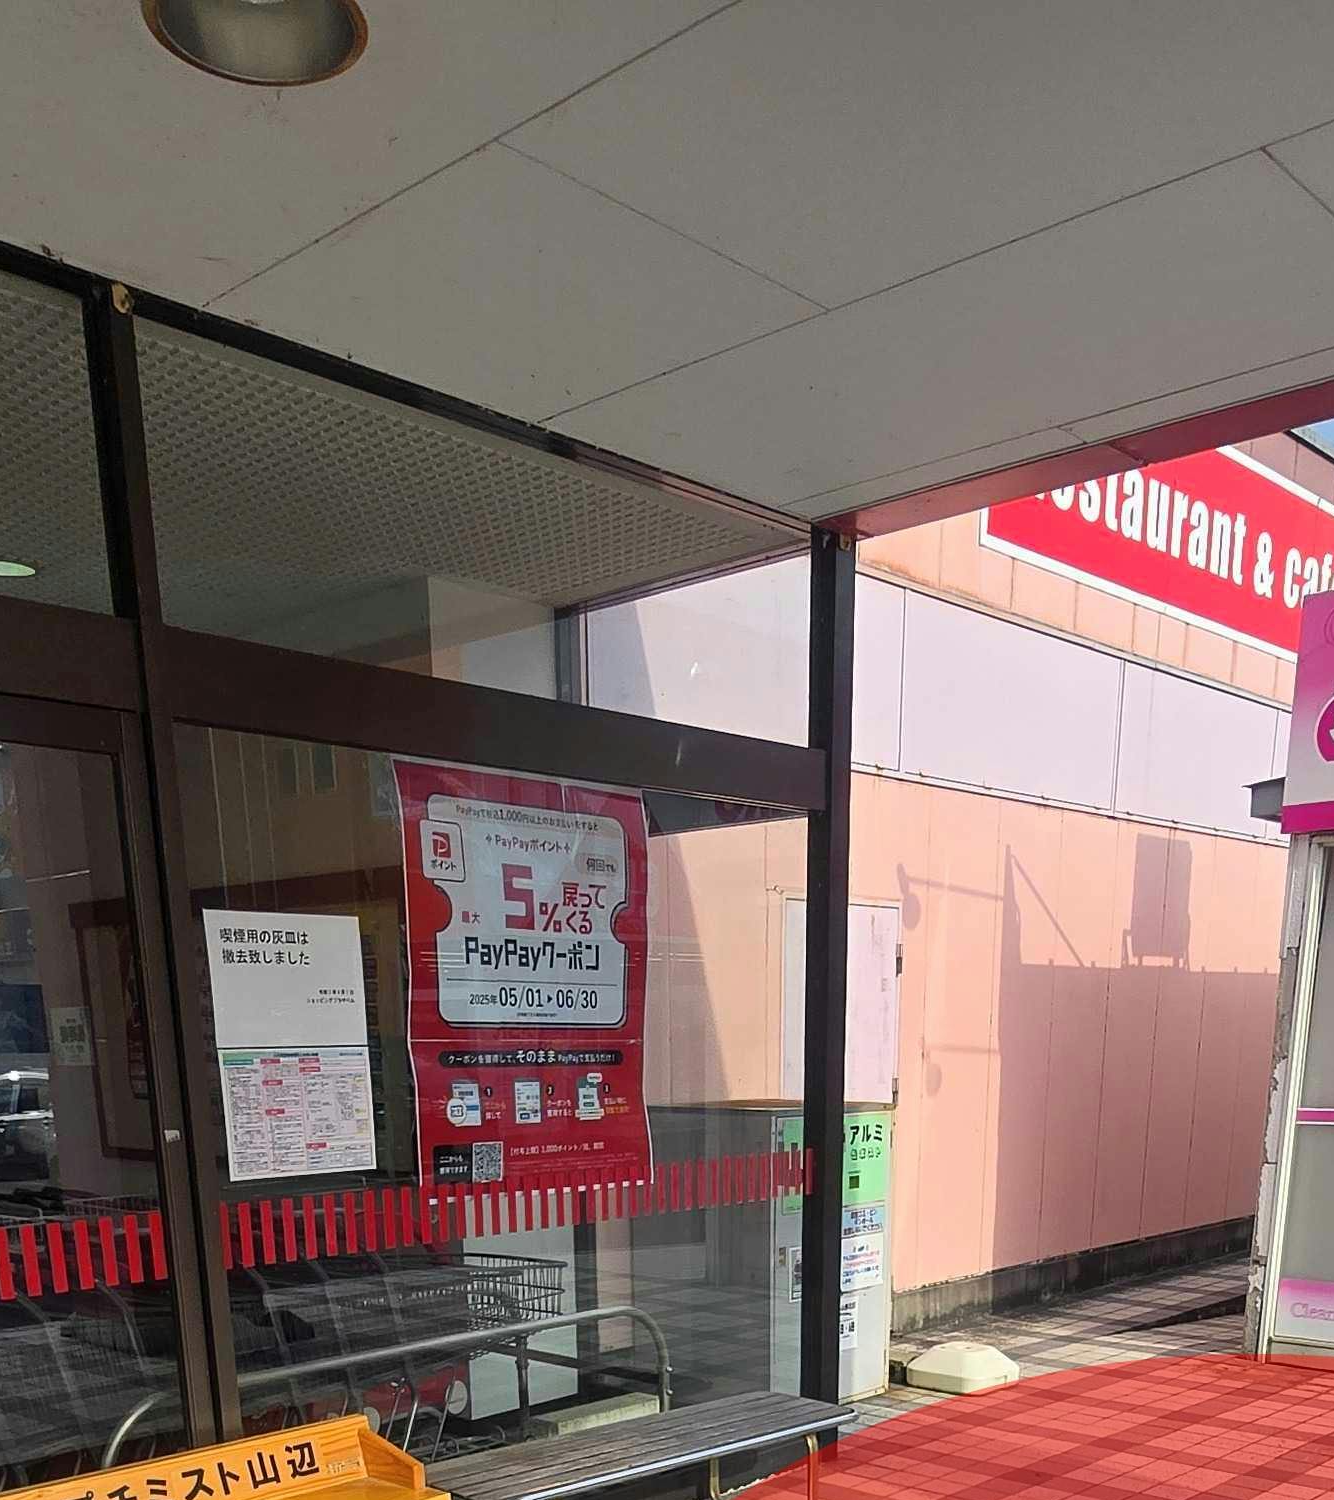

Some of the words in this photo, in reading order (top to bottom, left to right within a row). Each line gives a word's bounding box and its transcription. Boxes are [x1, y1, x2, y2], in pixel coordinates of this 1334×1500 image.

[1034, 469, 1247, 586] staurant
[1254, 532, 1274, 599] &
[494, 835, 565, 854] PayPayポイント
[430, 860, 457, 872] ポイント
[562, 881, 607, 910] 戻って
[565, 911, 594, 935] くる
[219, 927, 309, 945] 喫煙用の灰皿は
[222, 948, 310, 966] 撤去致しました
[465, 936, 601, 972] PayPayクーポン
[849, 1124, 884, 1146] アルミ
